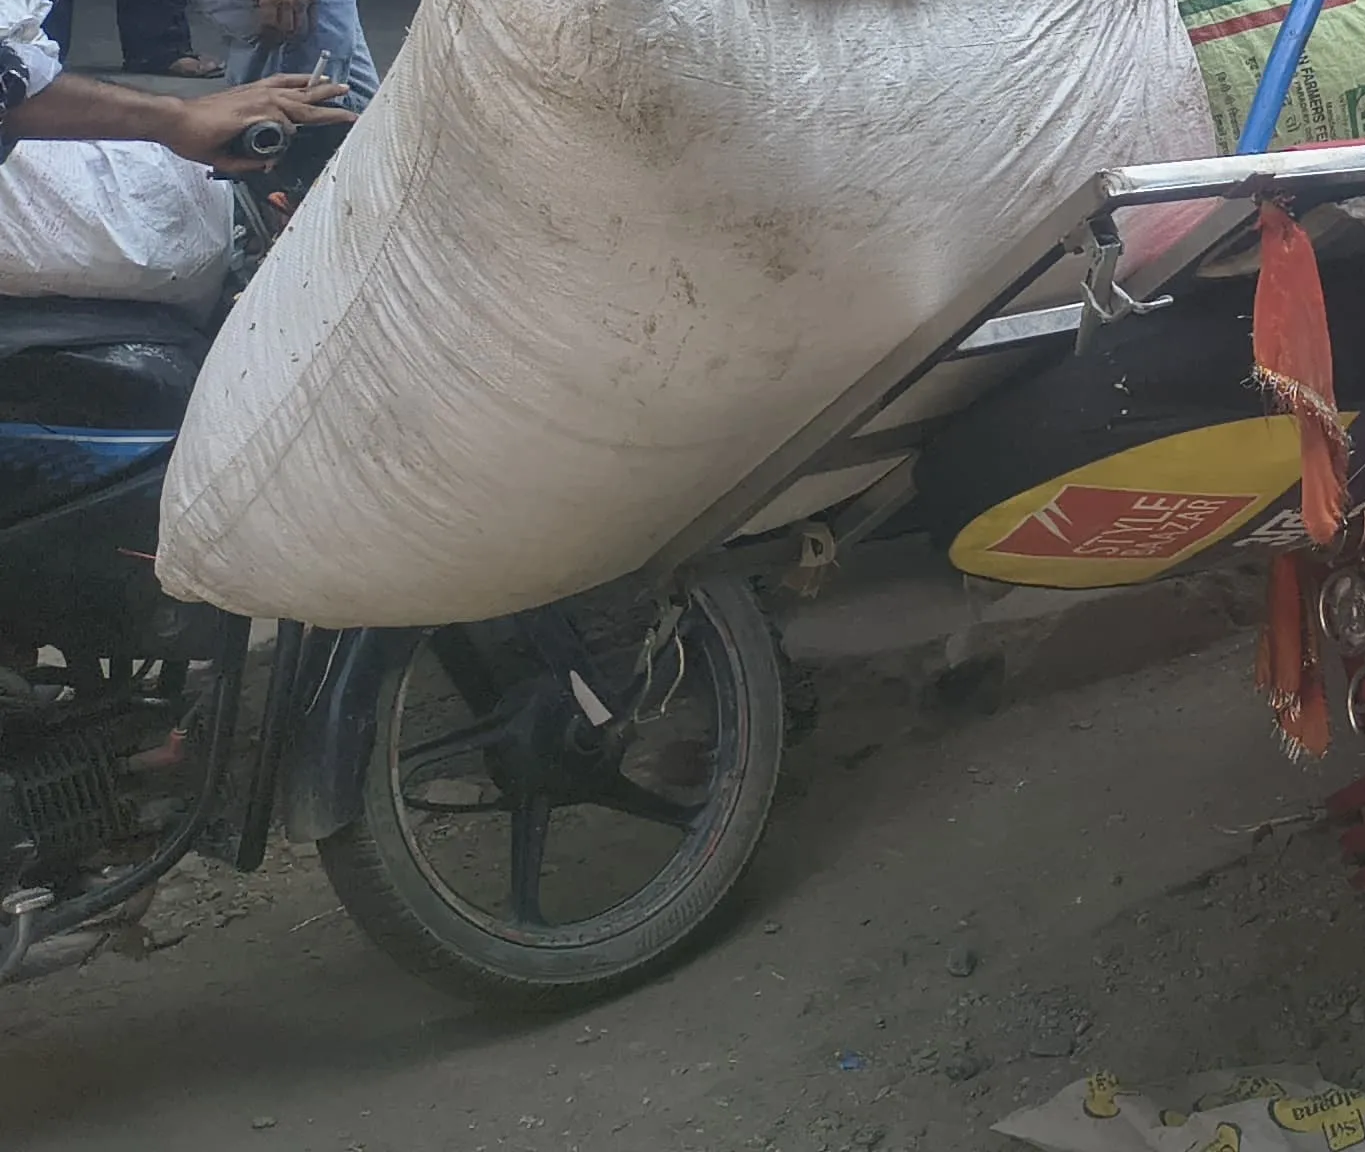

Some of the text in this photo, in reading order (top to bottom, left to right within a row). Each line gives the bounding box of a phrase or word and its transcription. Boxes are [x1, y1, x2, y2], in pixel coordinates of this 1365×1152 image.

[1300, 67, 1327, 124] FARMERS
[1072, 494, 1183, 556] STYLE
[1290, 1087, 1363, 1122] alpana
